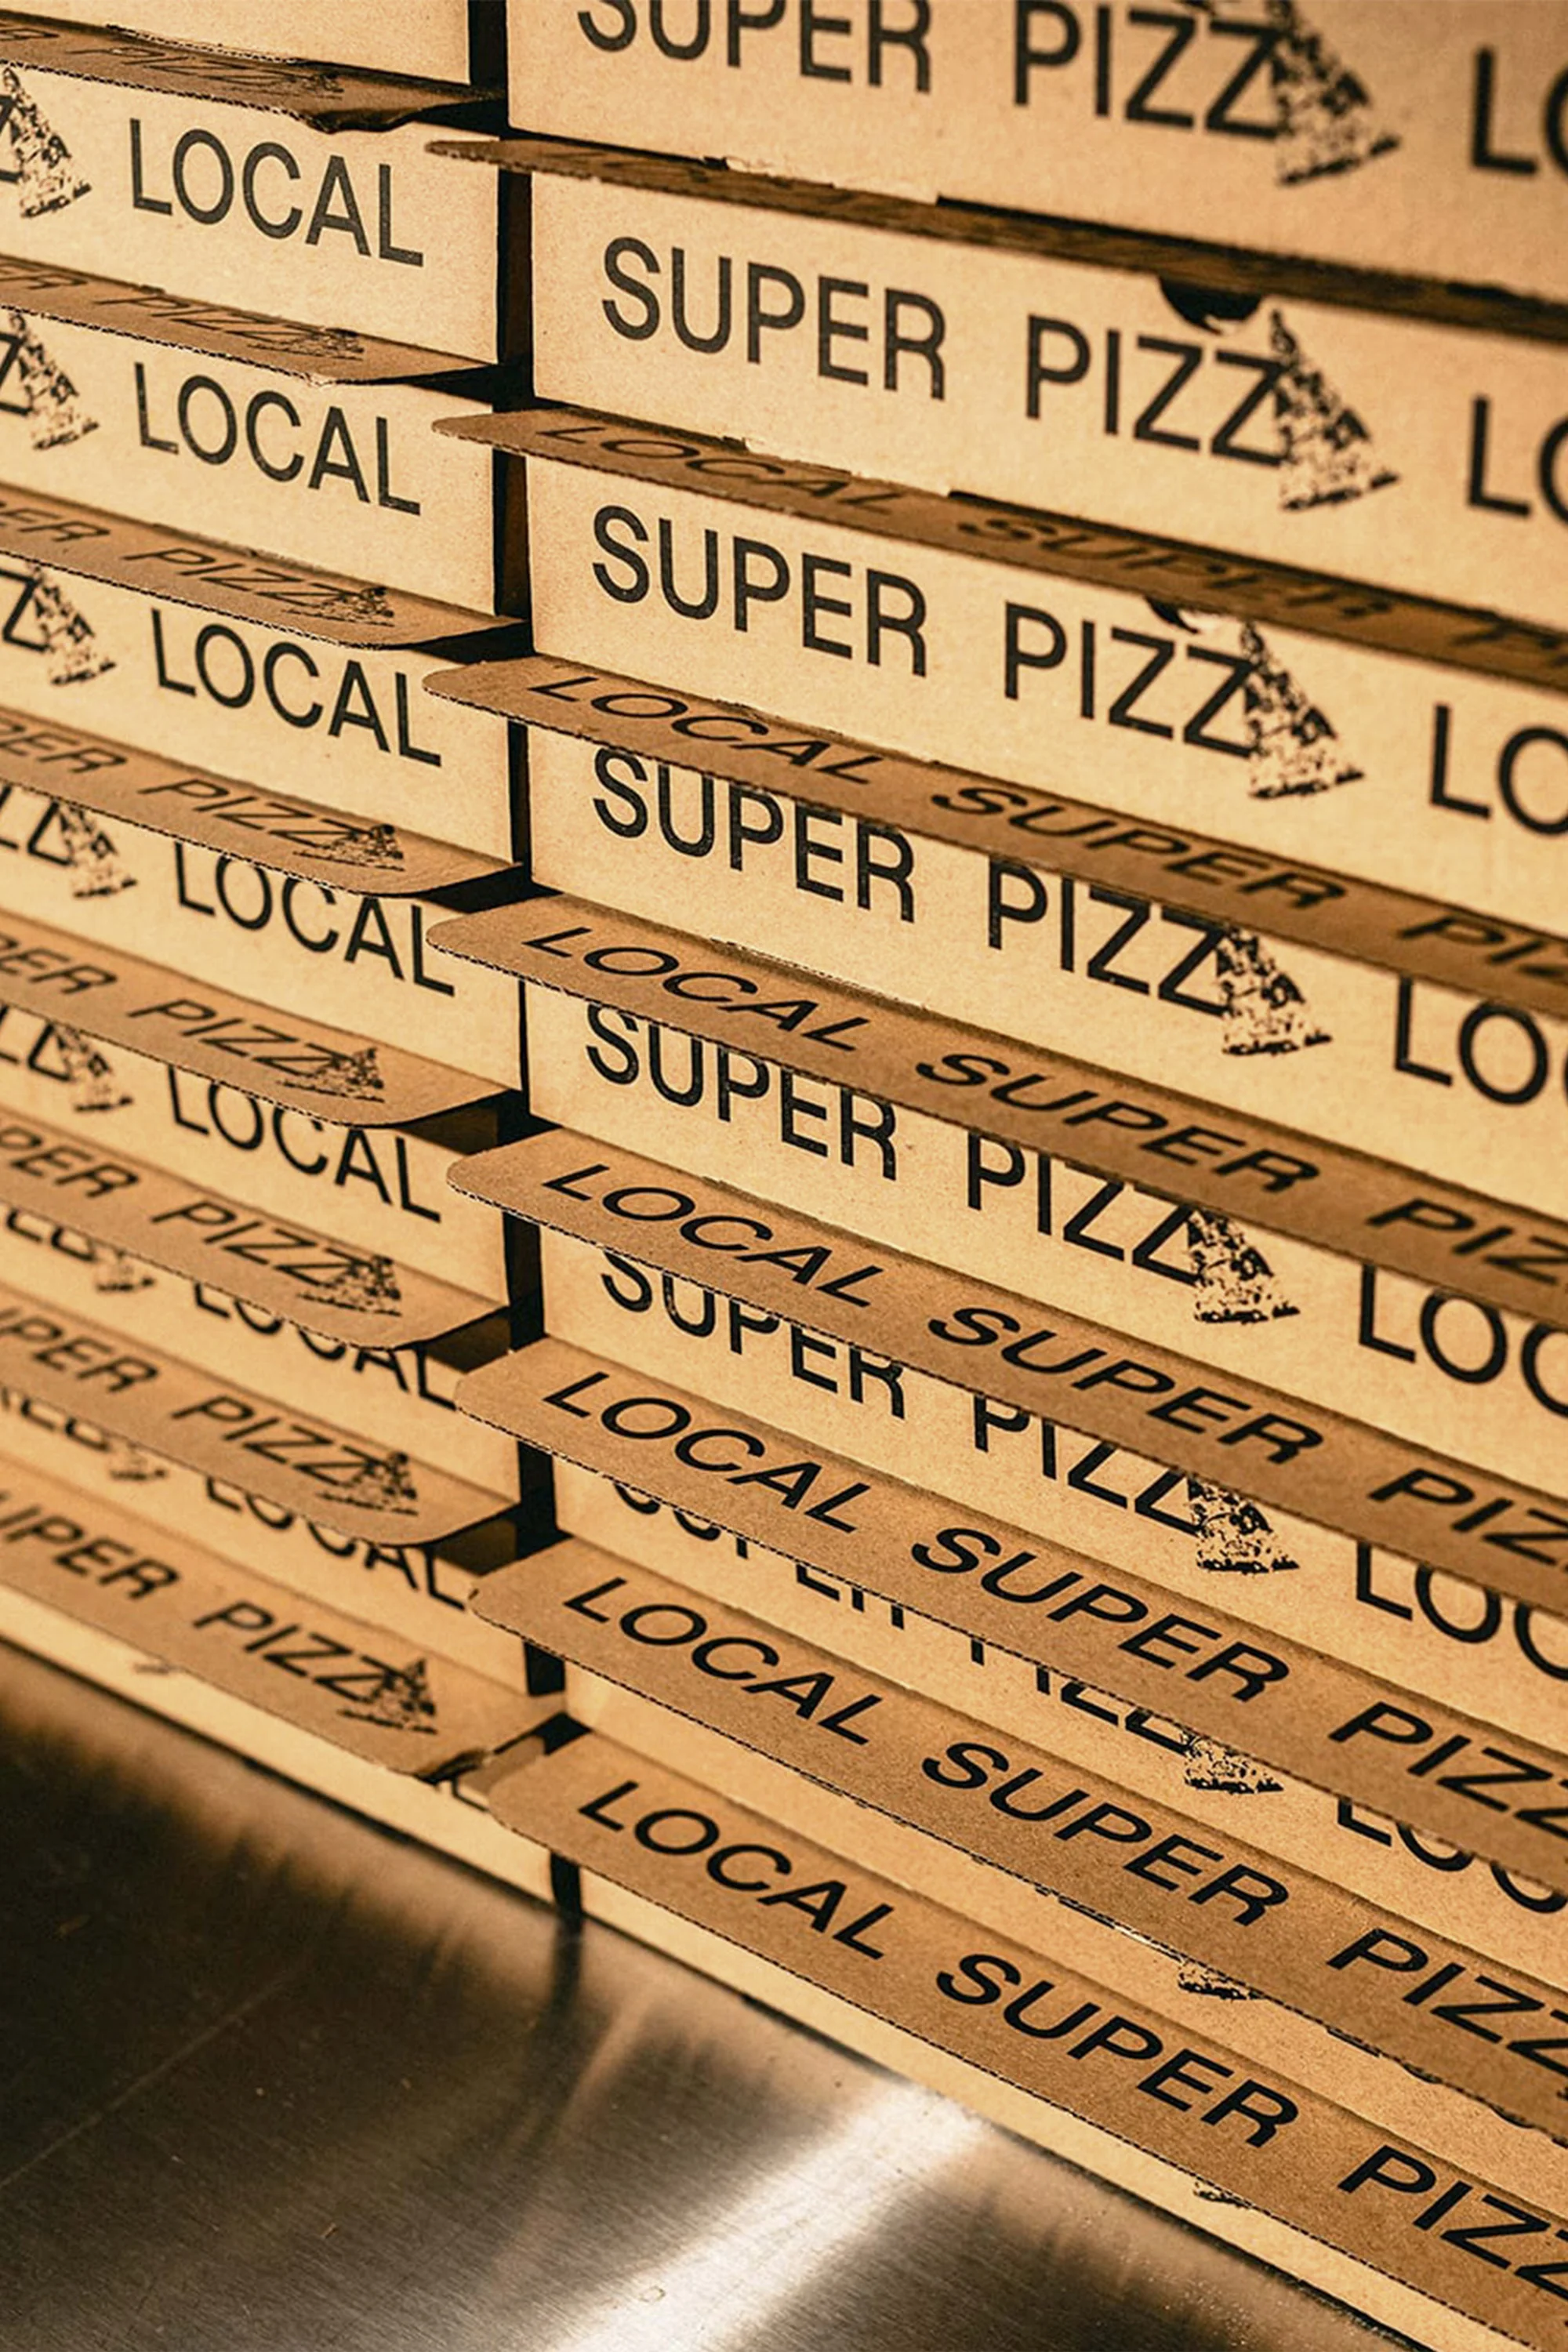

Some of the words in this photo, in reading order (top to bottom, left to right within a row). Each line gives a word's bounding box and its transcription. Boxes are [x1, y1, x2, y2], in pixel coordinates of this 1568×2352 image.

[130, 118, 424, 267] LOCAL
[601, 237, 946, 401] SUPER
[135, 362, 421, 517] LOCAL
[535, 424, 905, 514] LOCAL
[592, 506, 926, 677] SUPER
[151, 606, 442, 768] LOCAL
[527, 676, 884, 785] LOCAL
[932, 787, 1346, 909] SUPER
[593, 747, 915, 924] SUPER
[175, 843, 455, 996] LOCAL
[168, 1064, 441, 1223] LOCAL
[521, 926, 870, 1052] LOCAL
[916, 1053, 1321, 1193] SUPER
[586, 1004, 897, 1181] SUPER
[541, 1163, 884, 1308] LOCAL
[928, 1307, 1324, 1465] SUPER
[601, 1250, 905, 1420] SUPER
[543, 1370, 871, 1534] LOCAL
[911, 1527, 1290, 1702] SUPER
[563, 1577, 884, 1746] LOCAL
[921, 1741, 1290, 1926] SUPER
[577, 1780, 895, 1960] LOCAL
[935, 1953, 1299, 2149] SUPER
